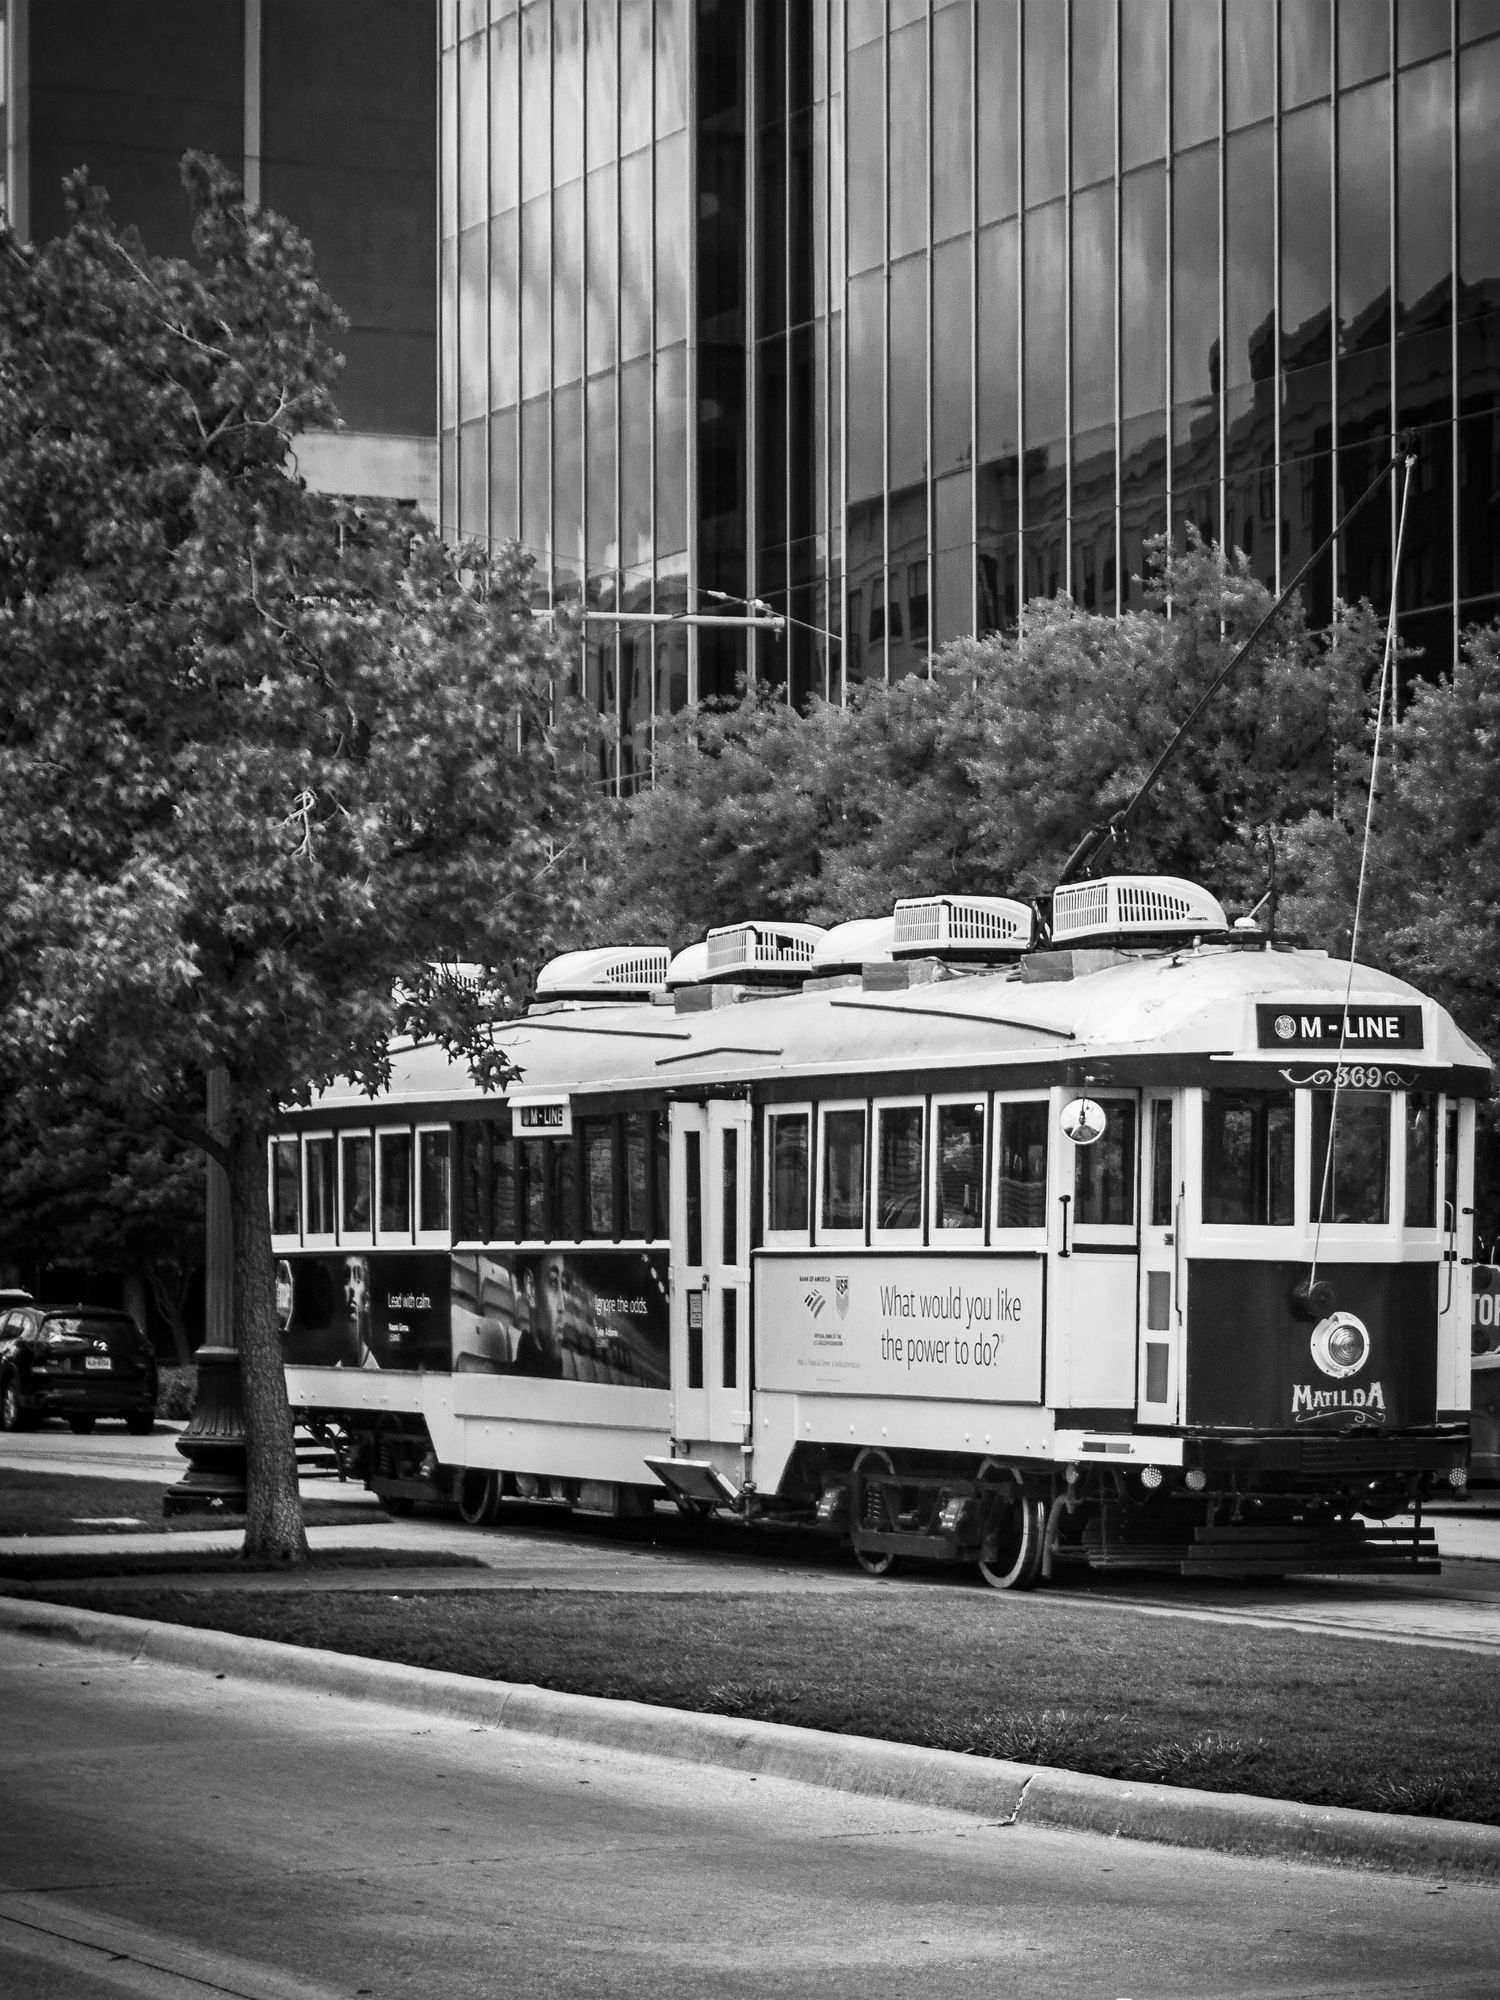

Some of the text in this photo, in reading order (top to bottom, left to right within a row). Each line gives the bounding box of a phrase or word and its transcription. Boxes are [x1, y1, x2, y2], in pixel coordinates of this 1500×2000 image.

[1334, 1066, 1383, 1088] 369
[617, 1295, 629, 1313] the
[880, 1285, 1022, 1329] What would you like
[881, 1328, 903, 1361] the
[907, 1337, 950, 1370] power
[954, 1336, 970, 1365] to
[1291, 1381, 1386, 1412] MATILDA
